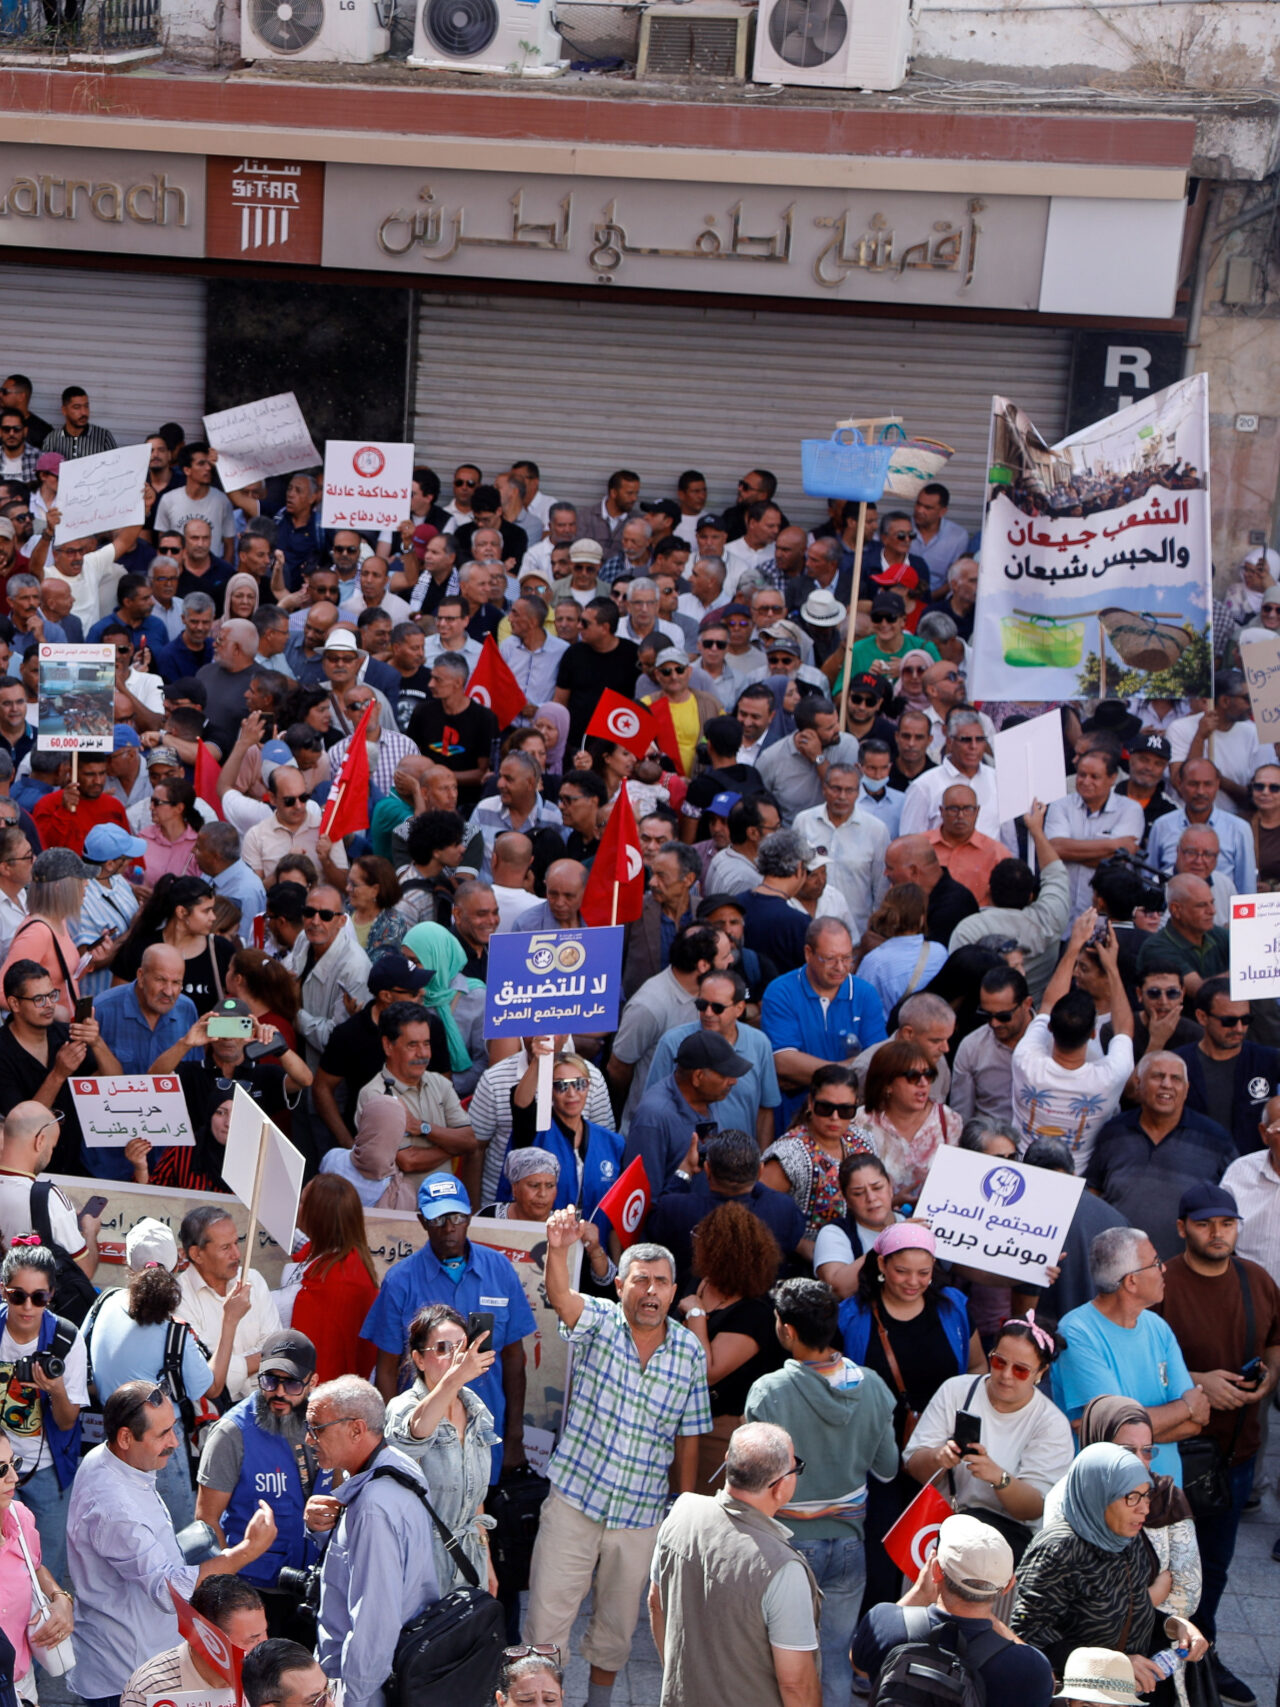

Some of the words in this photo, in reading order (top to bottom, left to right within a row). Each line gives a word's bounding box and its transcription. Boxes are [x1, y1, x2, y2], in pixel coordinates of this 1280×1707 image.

[232, 157, 302, 179] سيتار
[378, 184, 573, 262] لطرش
[588, 193, 796, 283] لطفي
[811, 197, 986, 296] أقمشة
[326, 483, 354, 496] عادلة
[358, 485, 398, 498] محاكمة
[401, 488, 407, 498] لا
[331, 512, 346, 523] حر
[350, 510, 374, 527] دفاع
[376, 512, 397, 526] دون
[1103, 498, 1188, 536] الشعب
[1008, 521, 1097, 552] جيعان
[1092, 539, 1189, 577] والحبس
[1005, 555, 1087, 586] شبعان
[51, 738, 78, 748] 60,000
[494, 975, 586, 1005] للتضييق
[590, 974, 607, 994] لا
[492, 1008, 531, 1026] المدني
[533, 1005, 580, 1023] المجتمع
[583, 1003, 605, 1018] على
[108, 1080, 148, 1096] شغل
[104, 1100, 162, 1116] حرية
[89, 1121, 138, 1137] وطنية
[141, 1121, 188, 1136] كرامة
[927, 1199, 984, 1220] المدني
[985, 1213, 1058, 1240] المجتمع
[983, 1237, 1048, 1265] موش
[255, 1467, 288, 1499] snjt
